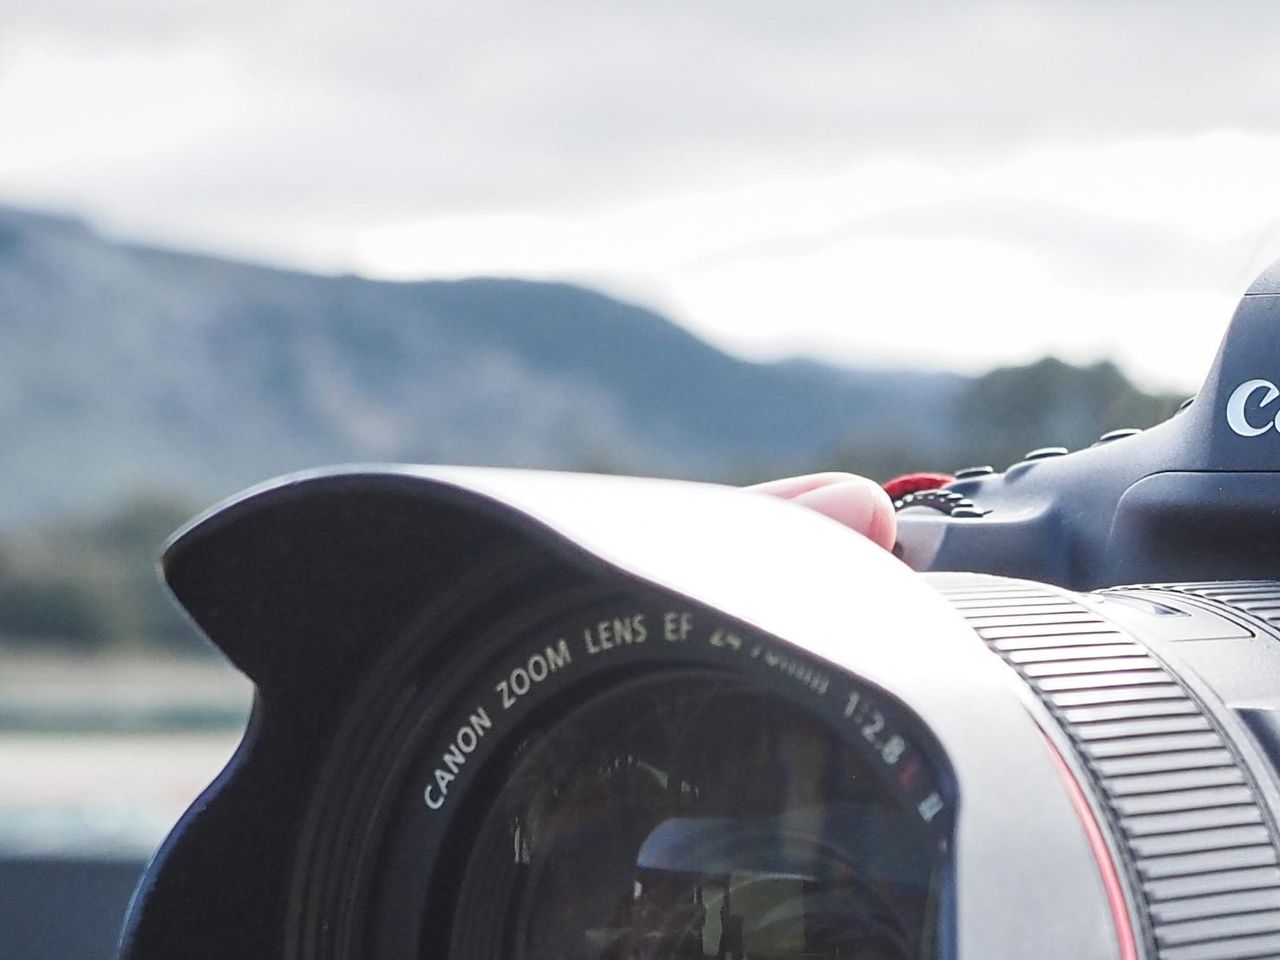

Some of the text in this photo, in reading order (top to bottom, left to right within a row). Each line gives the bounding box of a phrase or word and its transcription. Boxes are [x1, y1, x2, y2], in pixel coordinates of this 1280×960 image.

[423, 706, 493, 811] CANON
[496, 639, 572, 709] ZOOM
[584, 612, 648, 655] LENS
[664, 609, 694, 643] EF
